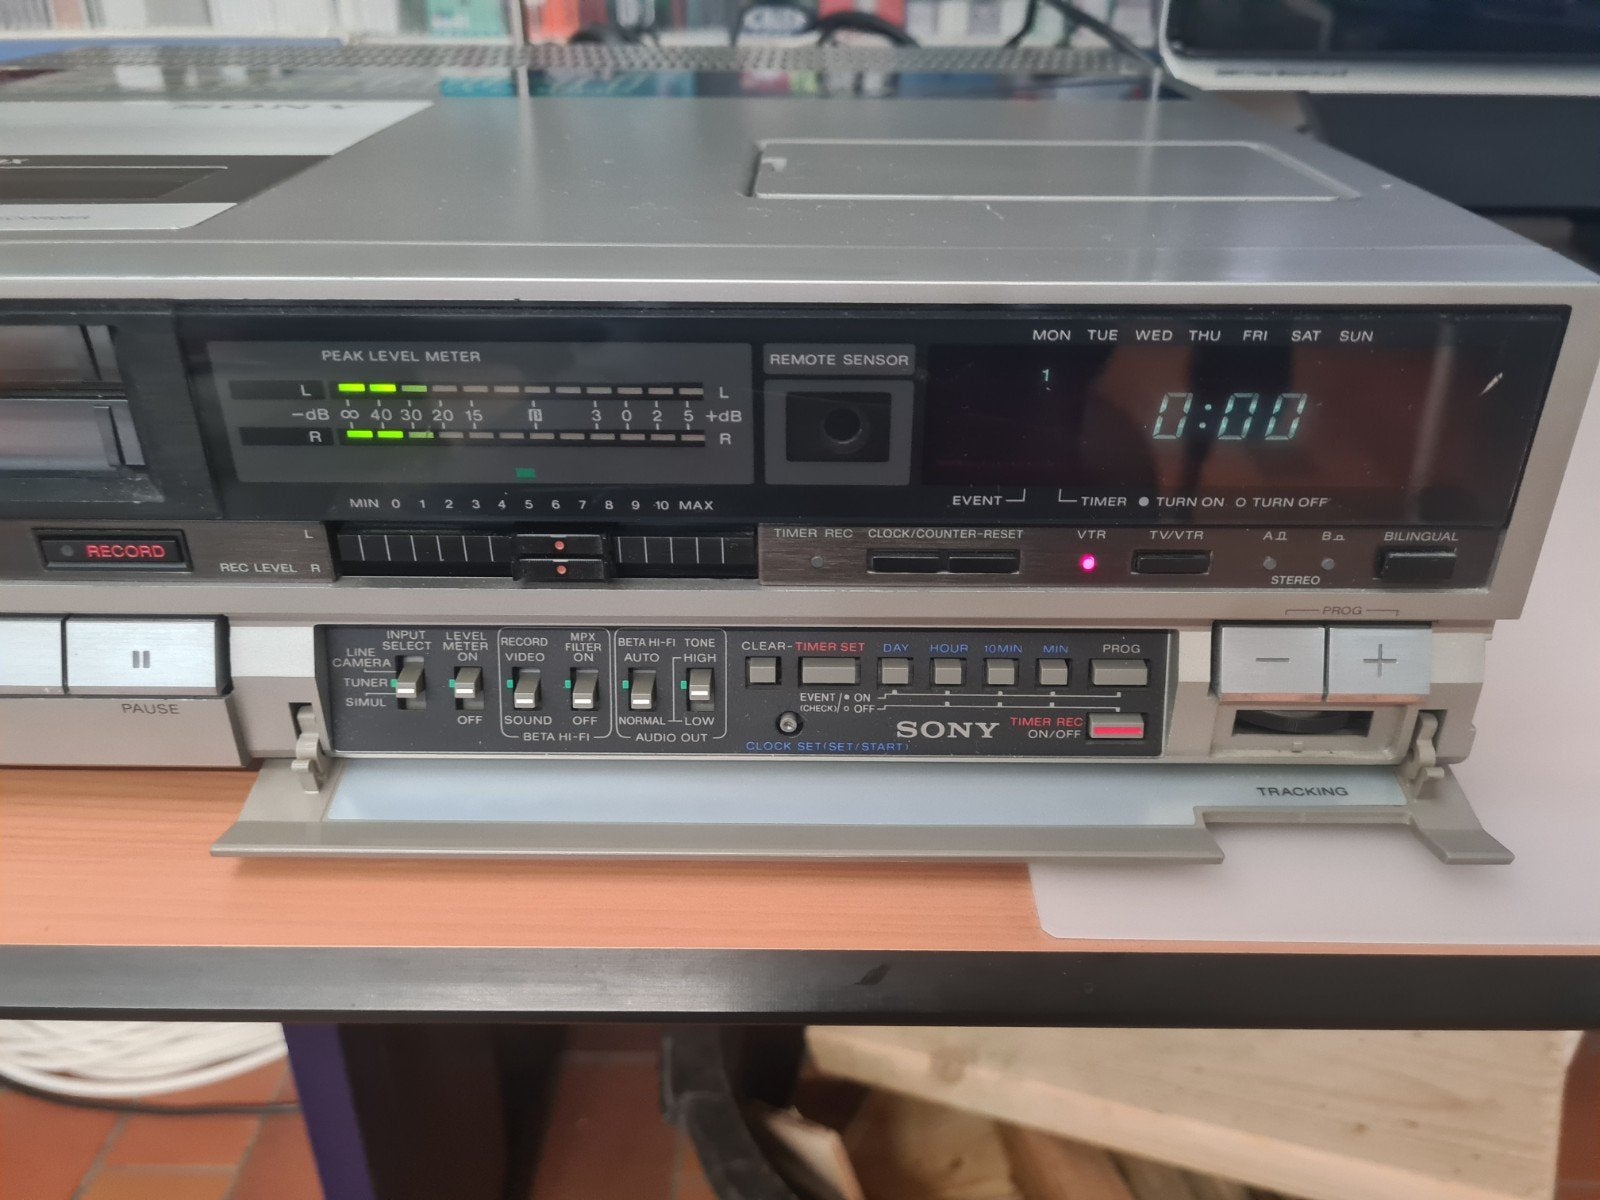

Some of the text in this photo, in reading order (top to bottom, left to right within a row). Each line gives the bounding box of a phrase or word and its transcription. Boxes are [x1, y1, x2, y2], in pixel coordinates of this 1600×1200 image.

[1033, 330, 1374, 341] MON TUE WED THU FRI SAT SUN
[322, 350, 481, 362] PEAK LEVEL METER
[770, 354, 909, 366] REMOTE SENSOR
[1042, 369, 1050, 382] 1
[300, 385, 311, 397] L
[719, 387, 729, 399] L
[370, 409, 393, 421] 40
[400, 409, 422, 421] 30
[432, 409, 454, 422] 20
[466, 409, 483, 421] 15
[591, 410, 602, 422] 3
[621, 410, 632, 422] 0
[652, 410, 662, 422] 2
[683, 410, 694, 422] 5
[1152, 392, 1307, 441] 0:00
[310, 431, 322, 443] R
[720, 433, 731, 445] R
[350, 498, 713, 511] MIN 0 1 2 3 4 5 6 7 8 9 10 MAX
[952, 495, 1002, 506] EVENT
[1081, 496, 1127, 507] TIMER
[1156, 497, 1224, 507] TURN ON
[1252, 497, 1328, 508] TURN OFF
[305, 529, 314, 540] L
[774, 528, 854, 539] TIMER REC
[1077, 530, 1106, 540] VTR
[1150, 530, 1204, 540] TV/VTR
[1263, 531, 1273, 541] A
[1322, 532, 1331, 541] B
[1384, 531, 1459, 542] BILINGUAL
[86, 544, 166, 559] RECORD
[219, 563, 321, 573] REC LEVEL R
[1271, 575, 1320, 586] STEREO
[1322, 606, 1362, 616] PROG
[386, 630, 426, 640] INPUT
[446, 631, 487, 641] LEVEL
[570, 632, 596, 642] MPX
[382, 641, 432, 651] SELECT
[443, 641, 489, 651] METER
[501, 637, 548, 647] RECORD
[565, 642, 602, 652] FILTER
[618, 638, 676, 648] BETA HI-FI
[684, 638, 716, 648] TONE
[795, 641, 865, 652] TIMER SET
[346, 648, 376, 657] LINE
[883, 643, 909, 653] DAY
[930, 643, 969, 653] HOUR
[984, 644, 1023, 653] 10MIN
[1043, 645, 1069, 654] MIN
[1102, 644, 1141, 654] PROG
[457, 652, 478, 662] ON
[505, 652, 545, 662] VIDEO
[573, 653, 594, 662] ON
[624, 653, 660, 662] AUTO
[683, 653, 717, 663] HIGH
[332, 658, 392, 668] CAMERA
[344, 678, 388, 688] TUNER
[800, 692, 836, 702] EVENT
[854, 693, 871, 702] ON
[345, 698, 387, 707] SIMUL
[121, 703, 180, 715] PAUSE
[854, 704, 875, 714] OFF
[457, 715, 483, 725] OFF
[504, 715, 552, 725] SOUND
[572, 716, 598, 726] OFF
[618, 716, 666, 726] NORMAL
[684, 716, 716, 726] LOW
[1010, 717, 1084, 727] TIMER REC
[896, 720, 1000, 739] SONY
[1028, 729, 1081, 739] ON/OFF
[523, 732, 590, 742] BETA HI-FI
[635, 733, 708, 743] AUDIO OUT
[746, 741, 792, 751] CLOCK
[1256, 787, 1349, 797] TRACKING
